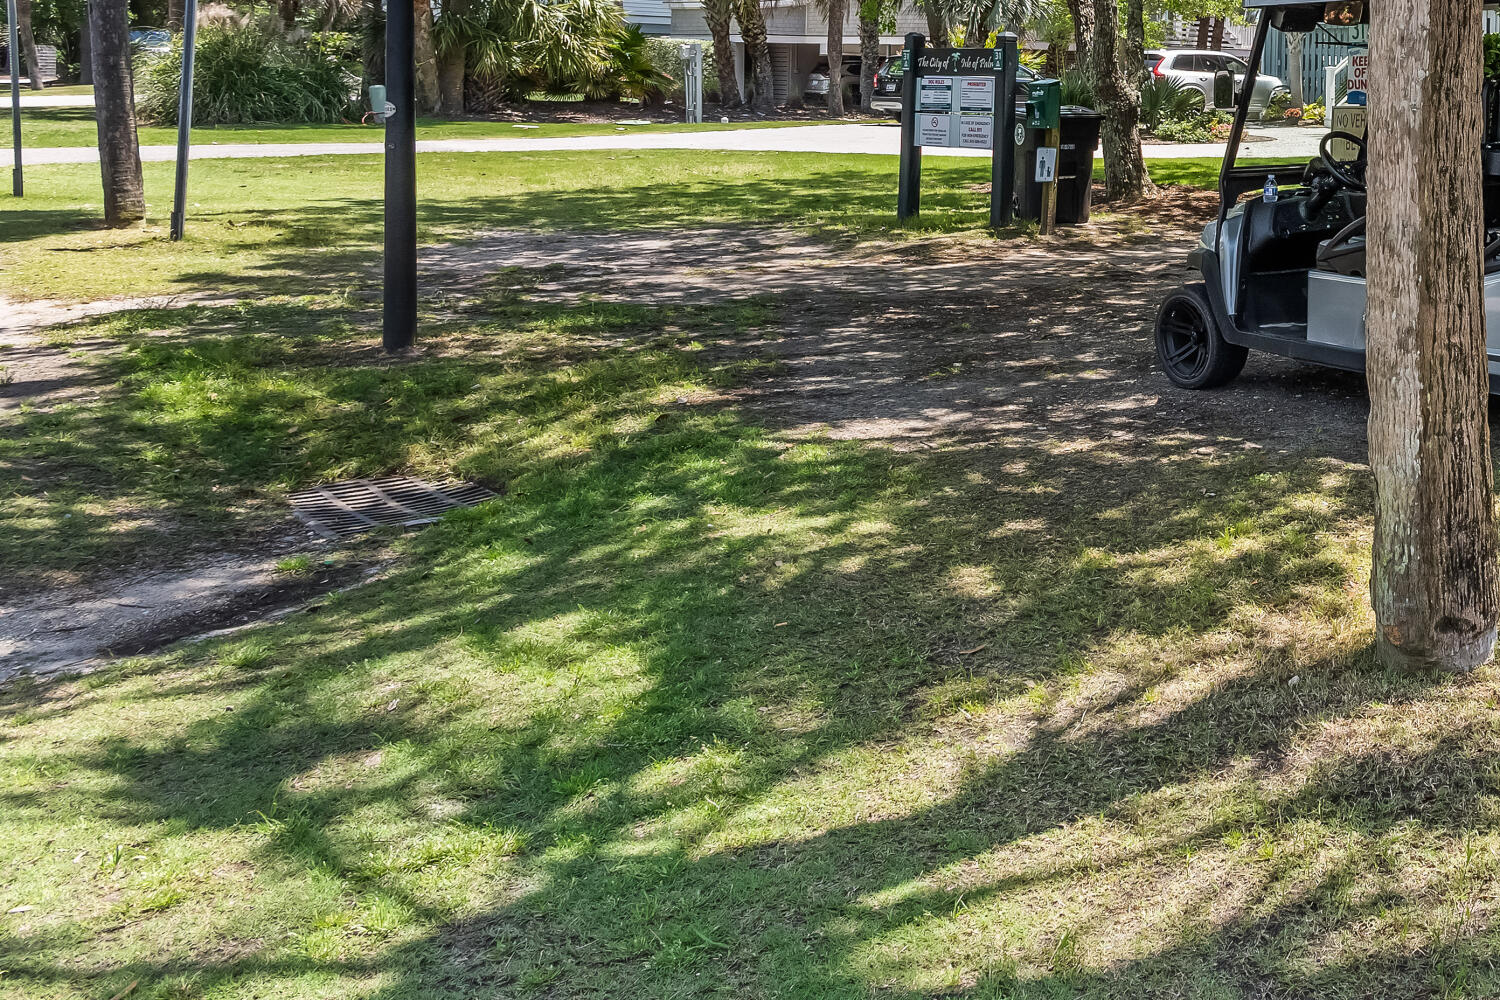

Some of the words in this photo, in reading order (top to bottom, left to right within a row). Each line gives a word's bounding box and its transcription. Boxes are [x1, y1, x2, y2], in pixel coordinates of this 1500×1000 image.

[995, 51, 1002, 60] 31
[1352, 56, 1368, 66] KEE
[917, 55, 929, 68] The
[929, 57, 942, 73] City
[942, 56, 950, 70] of
[960, 56, 971, 68] Isle
[972, 56, 980, 71] of
[1354, 68, 1367, 78] OF
[1347, 79, 1368, 90] DUN
[1337, 113, 1349, 128] NO
